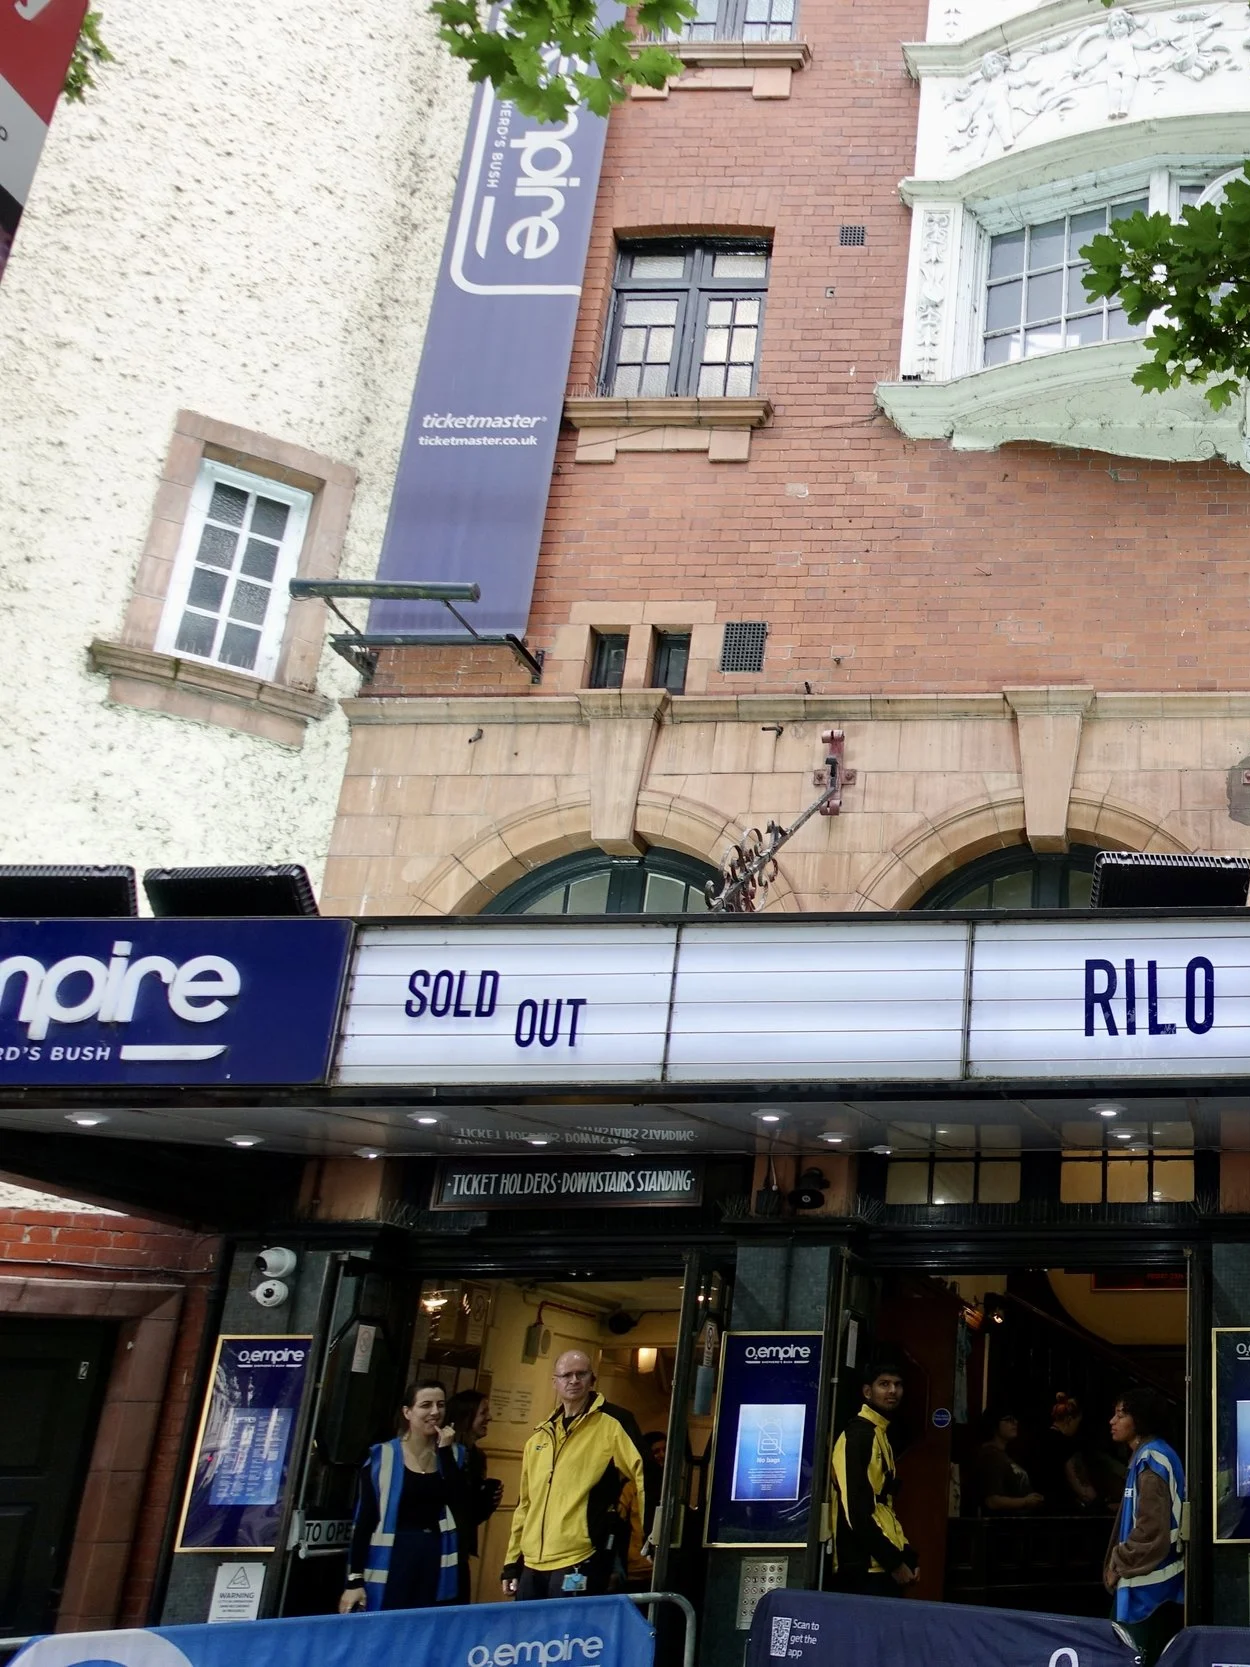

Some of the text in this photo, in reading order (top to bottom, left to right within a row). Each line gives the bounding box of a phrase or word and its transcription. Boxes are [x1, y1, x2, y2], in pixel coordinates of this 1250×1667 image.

[486, 152, 504, 188] BUSH
[422, 412, 541, 429] ticketmaster
[418, 435, 538, 446] ticketmaster.co.uk
[1084, 956, 1214, 1037] RILO
[404, 969, 587, 1048] SOLD OUT
[49, 1046, 111, 1061] BUSH
[453, 1169, 692, 1196] TICKET HOLDERS DOWNSTAIRS STANDING
[305, 1523, 322, 1541] TO
[793, 1619, 820, 1631] Scan to
[790, 1634, 817, 1645] get the
[787, 1648, 803, 1659] app
